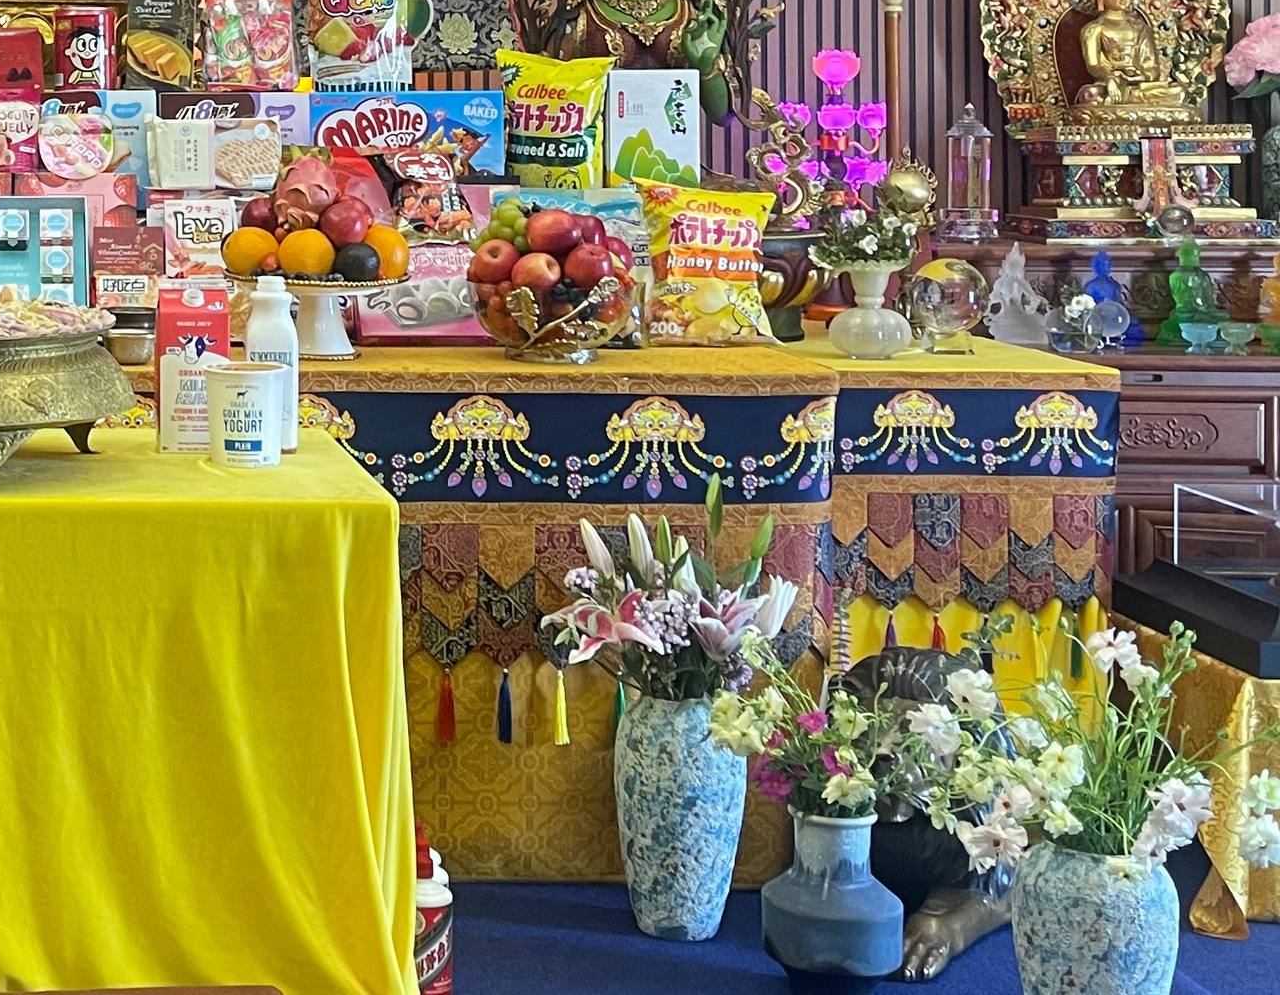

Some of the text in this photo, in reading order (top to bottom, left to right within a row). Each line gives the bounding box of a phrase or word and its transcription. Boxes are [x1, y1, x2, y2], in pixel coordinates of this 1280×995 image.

[516, 84, 567, 100] Calbee
[464, 104, 498, 120] BAKED
[2, 121, 34, 134] JELLY
[385, 132, 415, 149] BOY
[546, 144, 557, 157] &
[559, 142, 585, 157] Salt
[685, 199, 742, 217] Calbee
[173, 211, 224, 239] Lava
[666, 254, 764, 274] Honey Butter
[102, 278, 146, 292] 好吃点
[649, 321, 685, 337] 200g
[176, 392, 208, 404] A2/A
[223, 408, 263, 420] GOAT MILK
[223, 419, 263, 433] YOGURT
